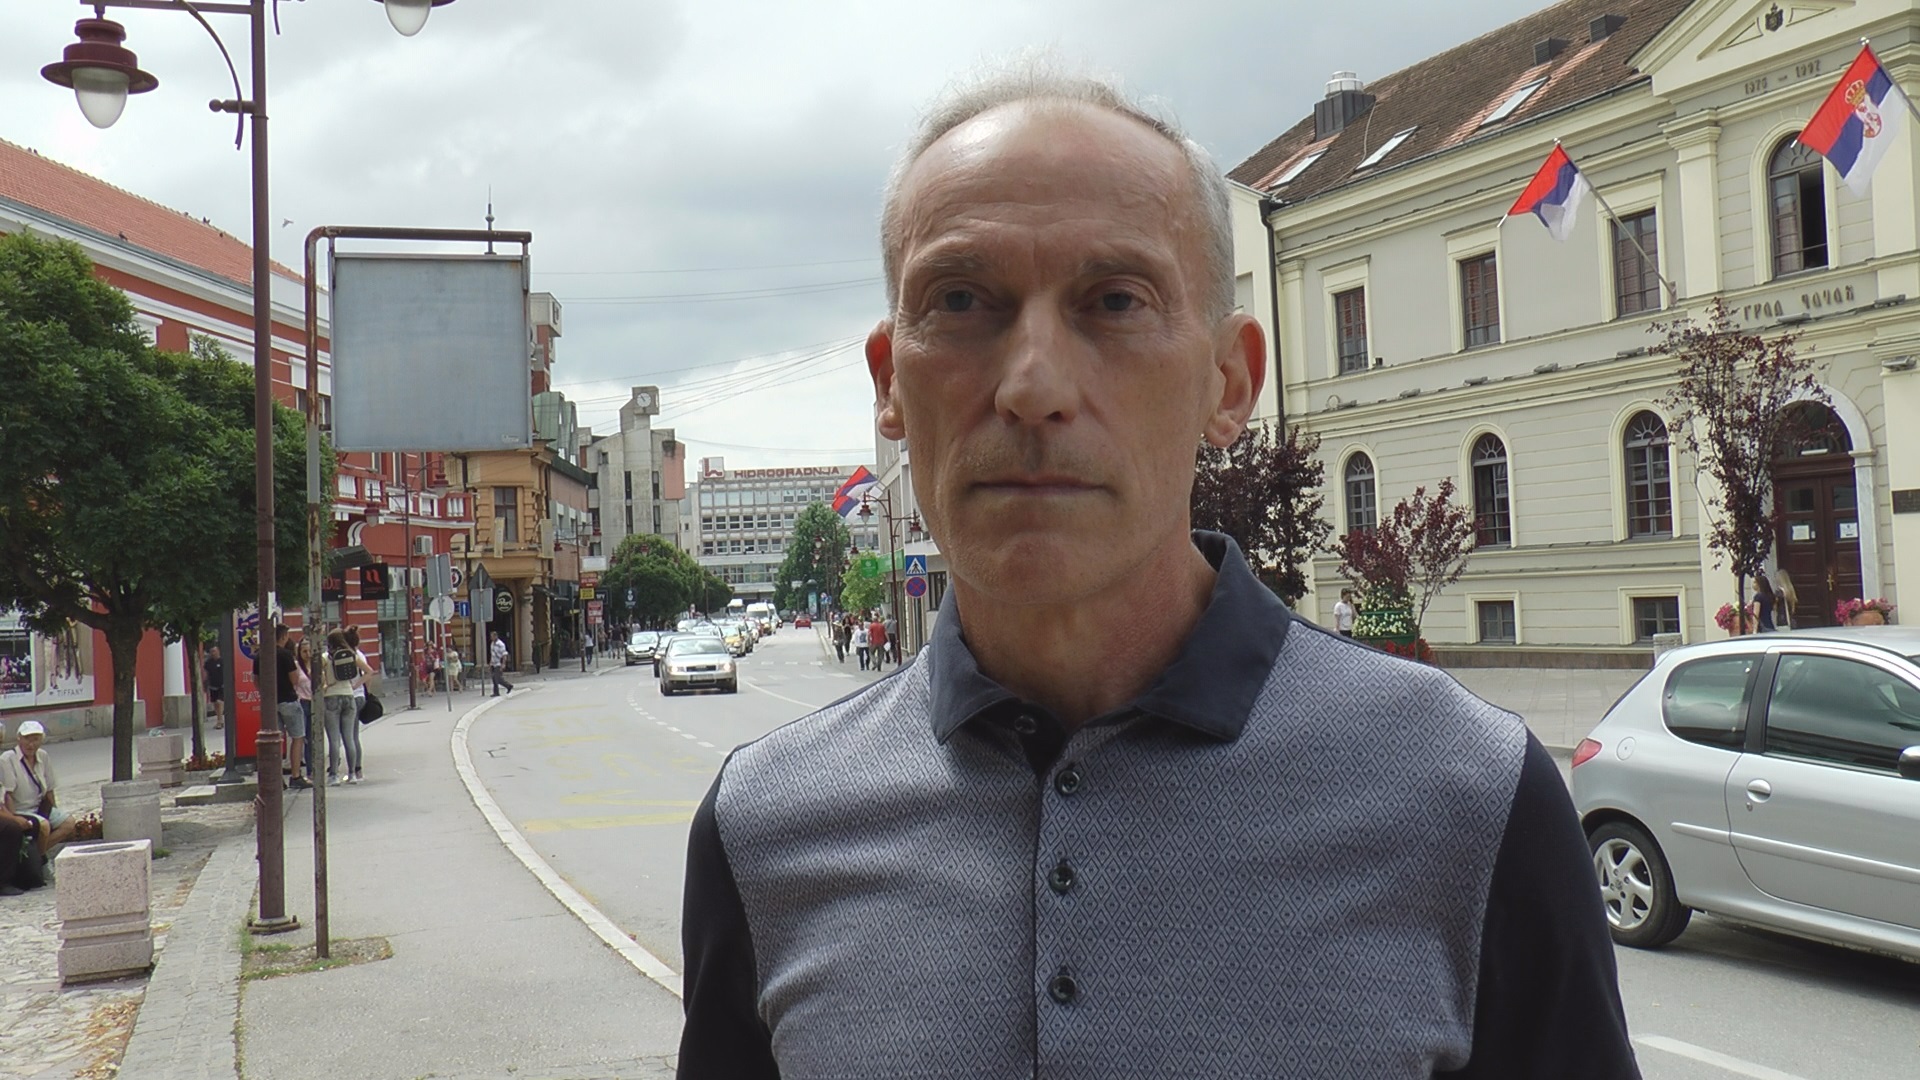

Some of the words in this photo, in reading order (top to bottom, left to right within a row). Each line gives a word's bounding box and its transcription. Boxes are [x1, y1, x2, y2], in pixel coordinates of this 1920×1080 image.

[1743, 299, 1784, 321] ГРАД
[1801, 285, 1854, 310] ЧАЧАК
[734, 465, 840, 479] HIDROGRADNJA
[57, 688, 84, 697] TIFFANY
